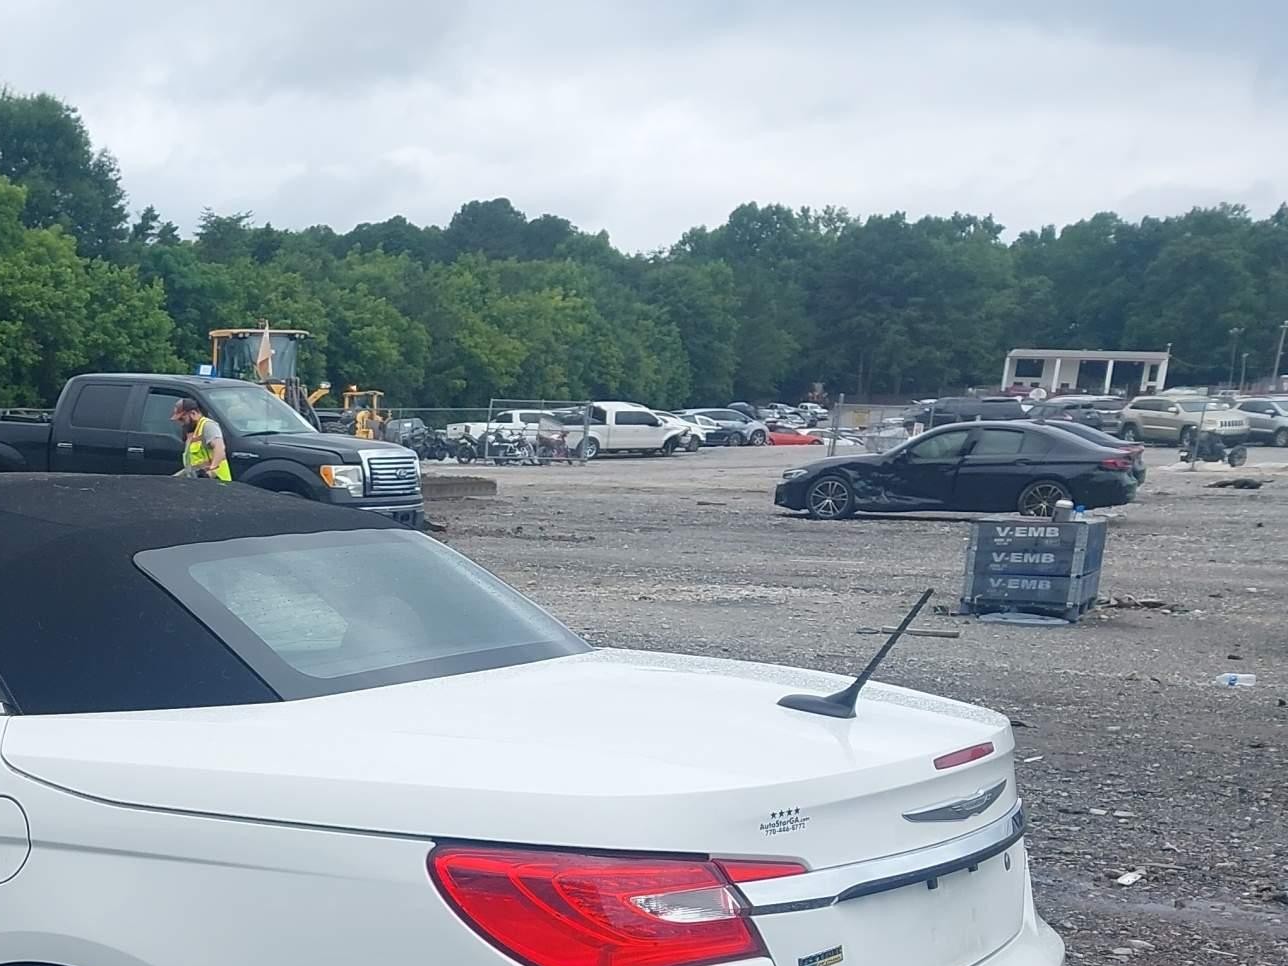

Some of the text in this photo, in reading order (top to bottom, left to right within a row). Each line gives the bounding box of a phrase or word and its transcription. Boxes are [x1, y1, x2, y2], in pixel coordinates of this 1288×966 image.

[995, 526, 1059, 537] V-EMB
[992, 552, 1055, 563] V-EMB
[989, 578, 1051, 590] V-EMB
